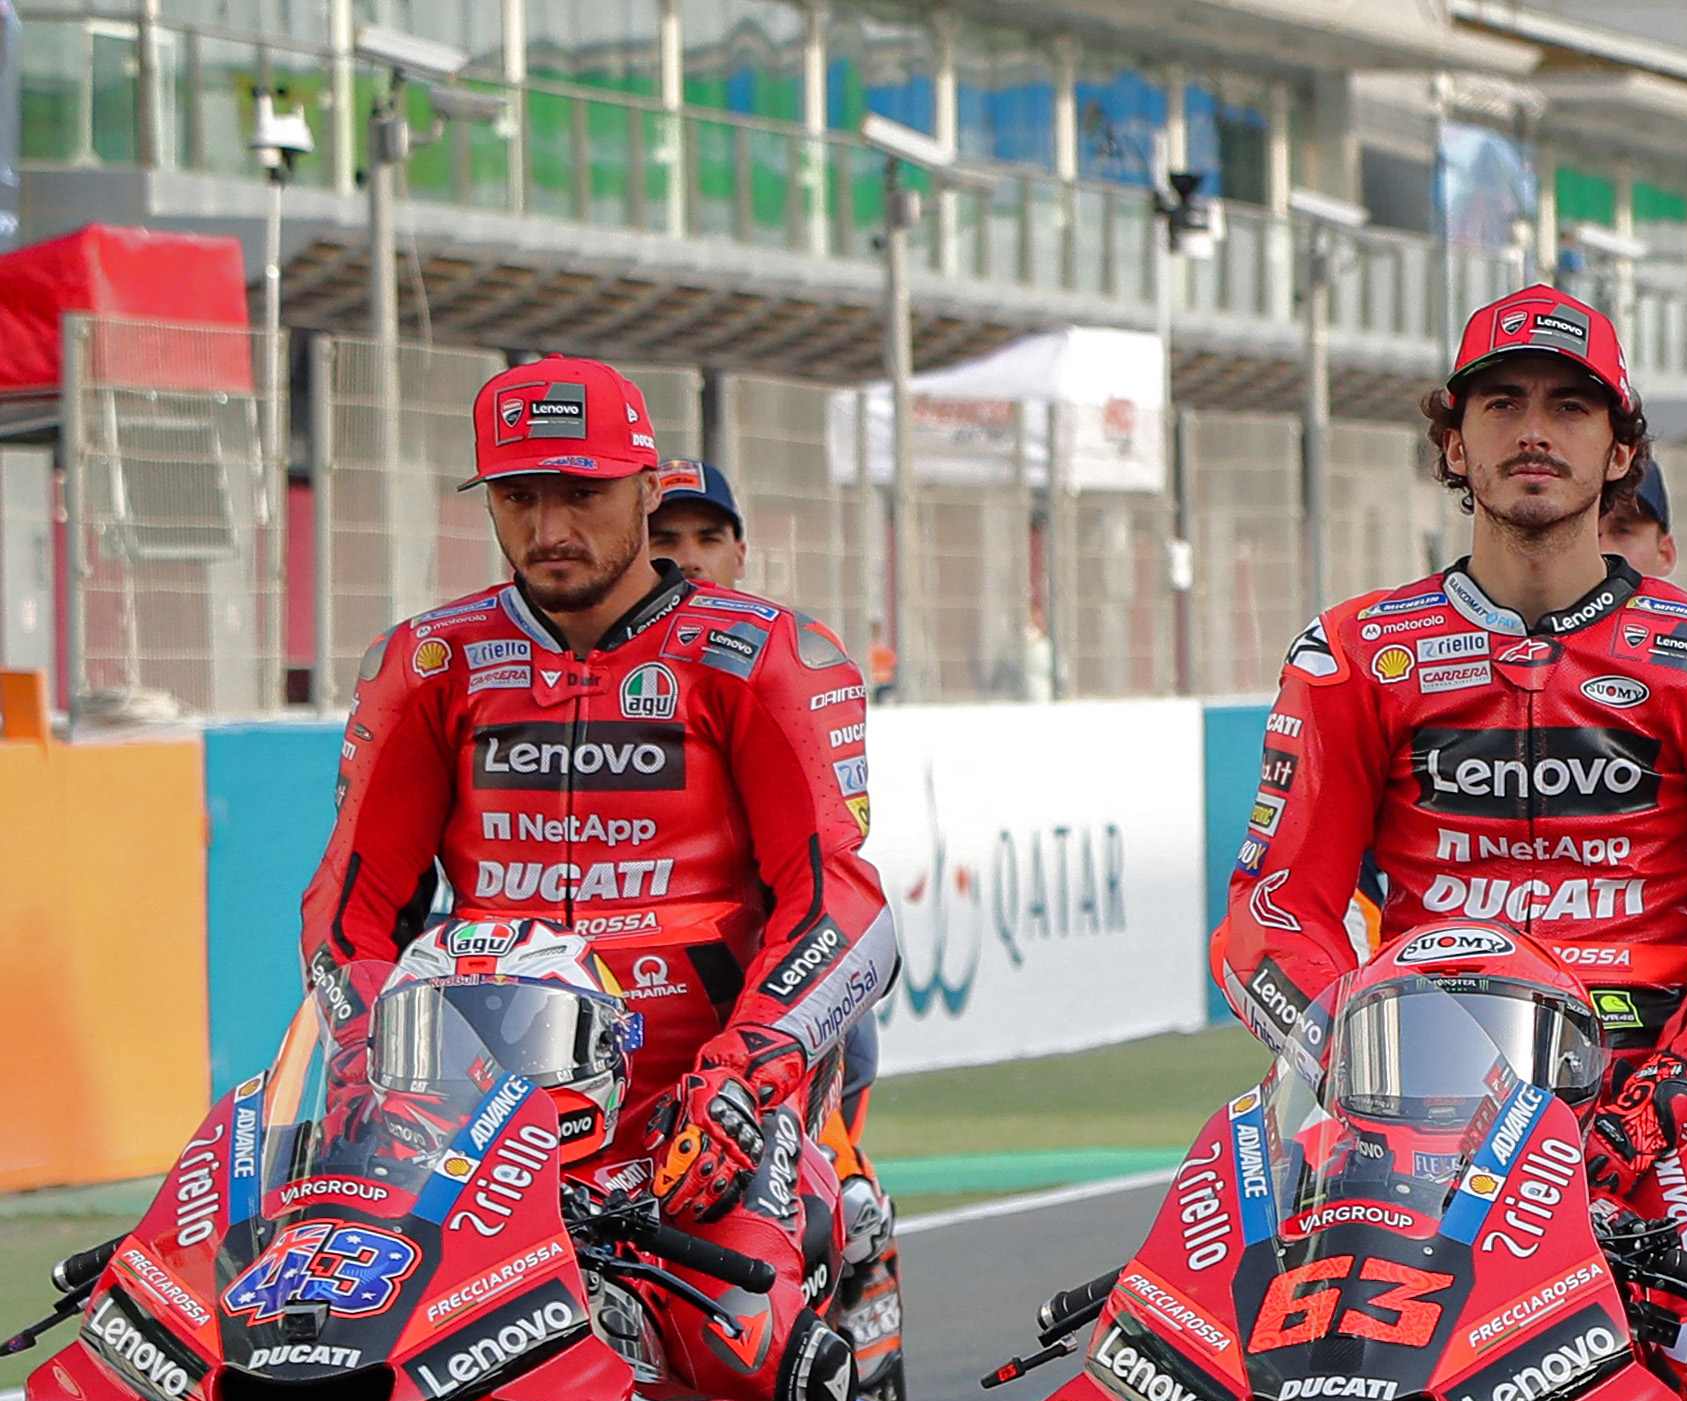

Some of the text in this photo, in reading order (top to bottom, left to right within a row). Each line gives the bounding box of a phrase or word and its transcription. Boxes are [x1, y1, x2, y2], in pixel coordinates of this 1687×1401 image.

[1536, 316, 1583, 337] Lenovo
[532, 402, 579, 415] Lenovo
[432, 614, 488, 630] motorola
[1382, 614, 1446, 634] motorola
[1552, 591, 1614, 632] Lenovo
[483, 640, 529, 659] riello
[709, 631, 753, 655] Lenovo
[1437, 636, 1485, 653] riello
[1422, 667, 1489, 685] CARRERA
[1587, 680, 1642, 703] SUOMY
[628, 694, 668, 718] agv
[484, 736, 667, 775] Lenovo
[1426, 747, 1643, 798] Lenovo
[518, 812, 657, 847] NetApp
[1478, 835, 1633, 867] NetApp
[474, 858, 675, 902] DUCATI
[992, 823, 1129, 969] QATAR
[1421, 874, 1647, 923] DUCATI
[456, 934, 507, 958] agv
[767, 927, 839, 998] Lenovo
[1405, 936, 1502, 961] SUOMY
[803, 958, 879, 1051] UnipolSai
[1250, 968, 1323, 1048] Lenovo
[469, 1074, 531, 1153] ADVANCE
[1491, 1085, 1545, 1166] ADVANCE
[234, 1105, 256, 1179] ADVANCE
[1233, 1123, 1269, 1199] ADVANCE
[176, 1142, 223, 1248] riello
[278, 1179, 389, 1205] VARGROUP
[486, 1123, 560, 1222] riello
[1514, 1138, 1582, 1253] riello
[1178, 1150, 1227, 1271] riello
[1298, 1206, 1415, 1231] VARGROUP
[121, 1248, 212, 1328] FRECCIAROSSA
[222, 1217, 422, 1327] 43
[426, 1239, 565, 1324] FRECCIAROSSA
[1123, 1272, 1229, 1354] FRECCIAROSSA
[1247, 1254, 1455, 1354] 63
[1469, 1262, 1605, 1349] FRECCIAROSSA
[88, 1297, 190, 1399] Lenovo
[247, 1345, 363, 1370] DUCATI
[416, 1298, 577, 1400] Lenovo
